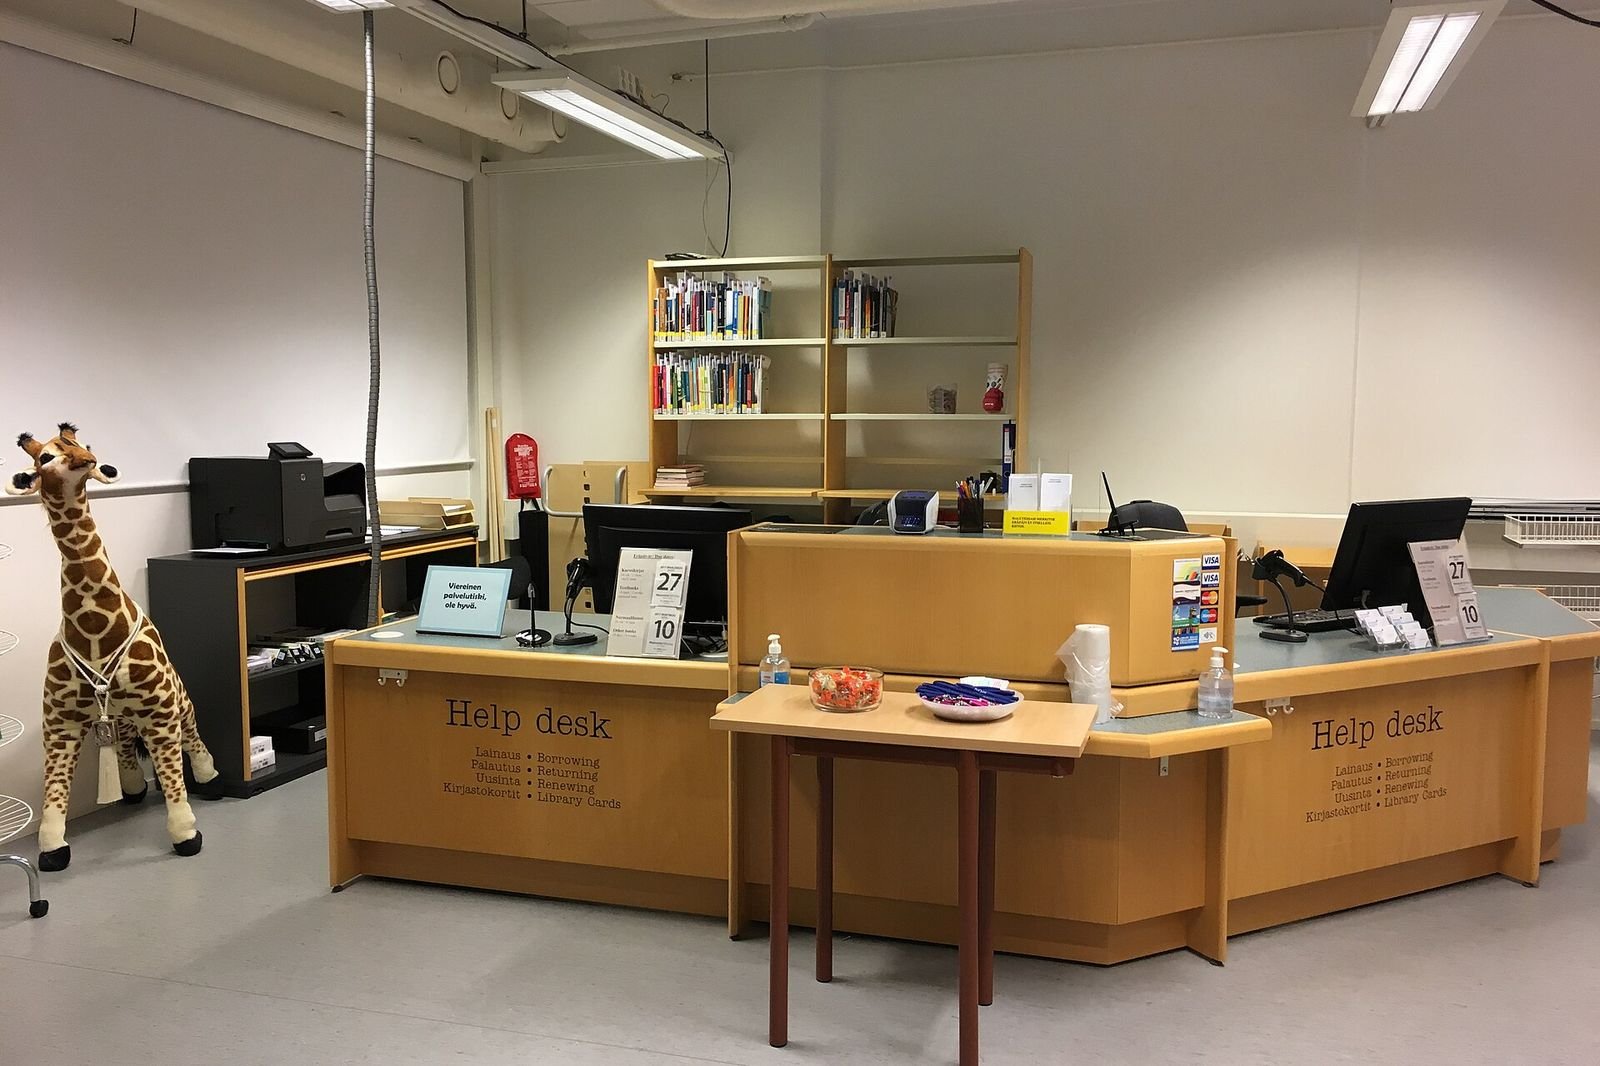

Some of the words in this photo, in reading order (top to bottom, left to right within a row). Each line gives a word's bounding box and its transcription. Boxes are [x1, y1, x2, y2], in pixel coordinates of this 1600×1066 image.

[1204, 556, 1219, 564] VISA
[1449, 562, 1465, 580] 27
[448, 582, 482, 591] Viereinen
[656, 573, 682, 591] 27
[1203, 574, 1218, 582] VISA
[443, 592, 487, 600] palvelutiski,
[456, 602, 477, 610] hyvä.
[1462, 605, 1478, 623] 10
[654, 620, 675, 639] 10
[446, 699, 521, 736] Help
[536, 707, 613, 739] desk
[1312, 717, 1375, 750] Help
[1386, 705, 1443, 738] desk
[475, 747, 521, 760] Lainaus
[537, 752, 600, 769] Borrowing
[1335, 762, 1373, 777] Lainaus
[1385, 751, 1434, 769] Borrowing
[471, 759, 521, 773] Palautus
[537, 765, 599, 782] Returning
[1331, 775, 1373, 791] Palautus
[1385, 764, 1432, 781] Returning
[476, 772, 521, 786] Uusinta
[537, 778, 595, 795] Renewing
[1335, 788, 1372, 803] Uusinta
[1384, 778, 1430, 795] Renewing
[443, 782, 521, 800] Kirjastokortit
[537, 792, 583, 807] Library
[587, 797, 621, 809] Cards
[1305, 801, 1371, 823] Kirjastokortit
[1384, 793, 1420, 808] Library
[1422, 786, 1448, 800] Cards
